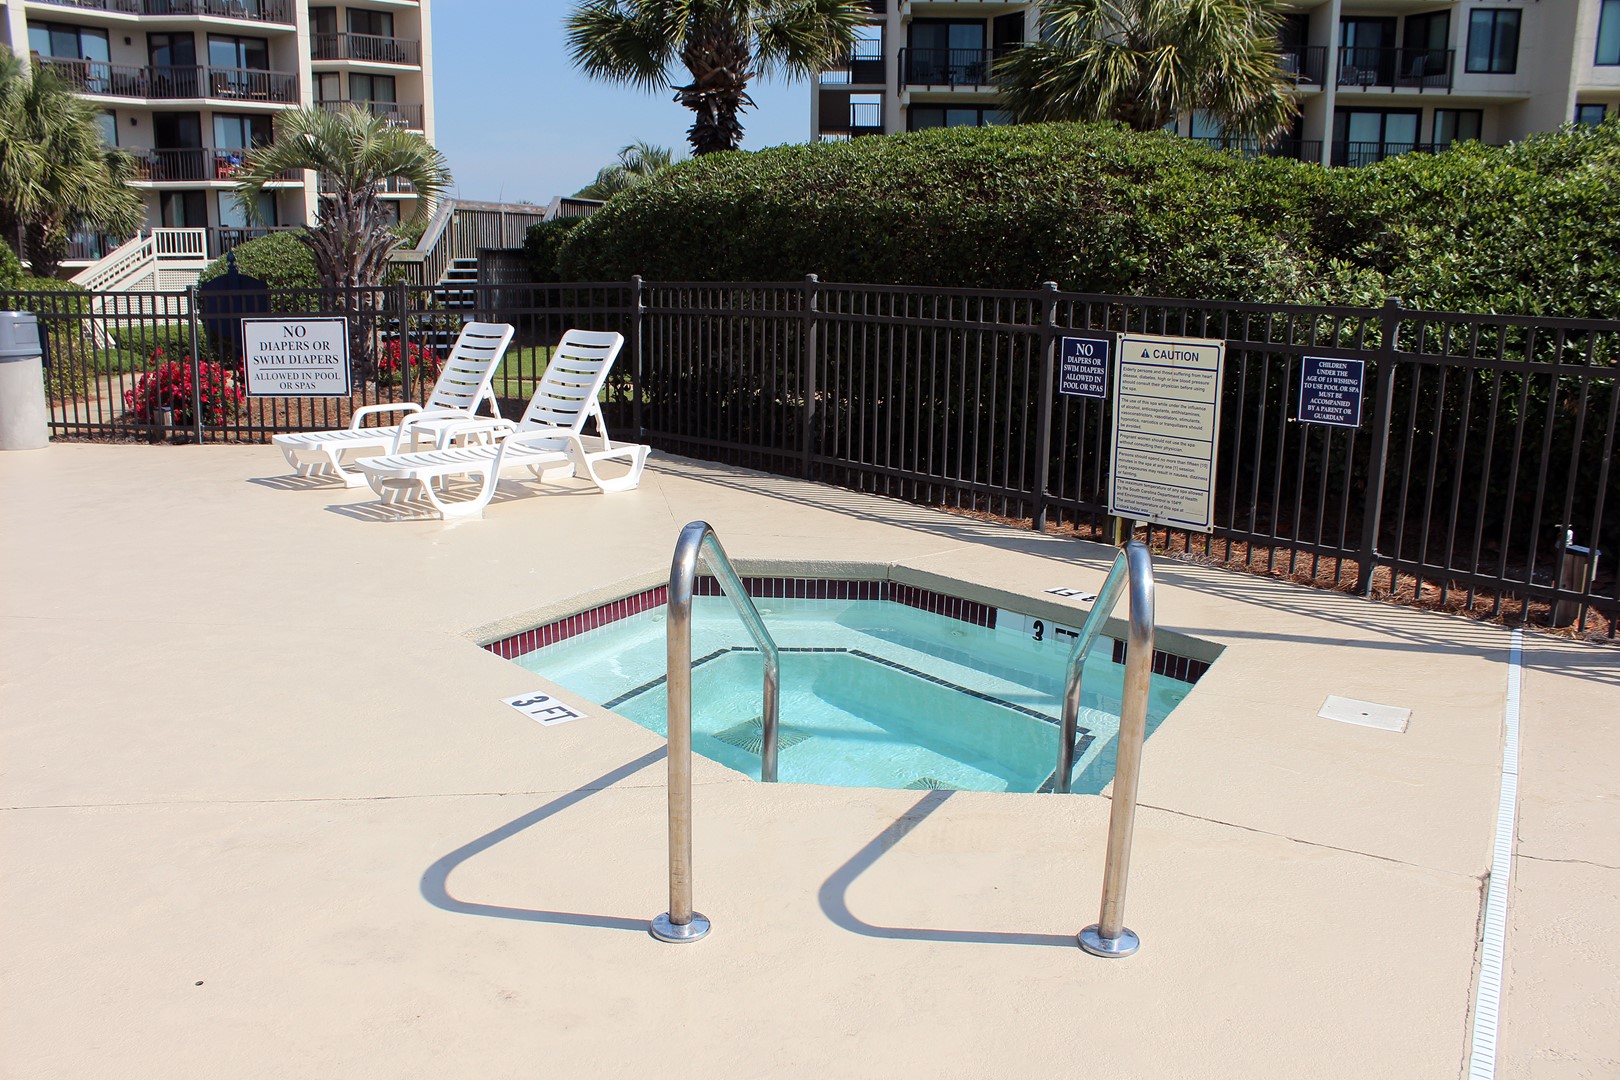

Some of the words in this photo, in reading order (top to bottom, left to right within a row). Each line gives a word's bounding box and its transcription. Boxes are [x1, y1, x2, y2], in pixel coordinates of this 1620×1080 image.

[283, 325, 306, 338] NO
[260, 341, 310, 351] DIAPERS
[312, 341, 331, 351] OR
[1077, 344, 1093, 356] NO
[1153, 349, 1200, 362] CAUTION
[253, 356, 285, 365] SWIM
[289, 355, 339, 364] DIAPERS
[1068, 356, 1091, 364] DIAPERS
[1080, 366, 1104, 374] DIAPERS
[254, 373, 299, 381] ALLOWED
[315, 372, 341, 380] POOL
[1066, 374, 1093, 382] ALLOWED
[279, 382, 293, 390] OR
[1311, 398, 1350, 406] ACCOMPANIED
[1125, 492, 1151, 500] Environmental
[1136, 500, 1158, 508] temperature
[1044, 588, 1083, 596] FT
[1032, 620, 1044, 641] 3
[511, 696, 550, 707] 3
[531, 706, 579, 722] FT
